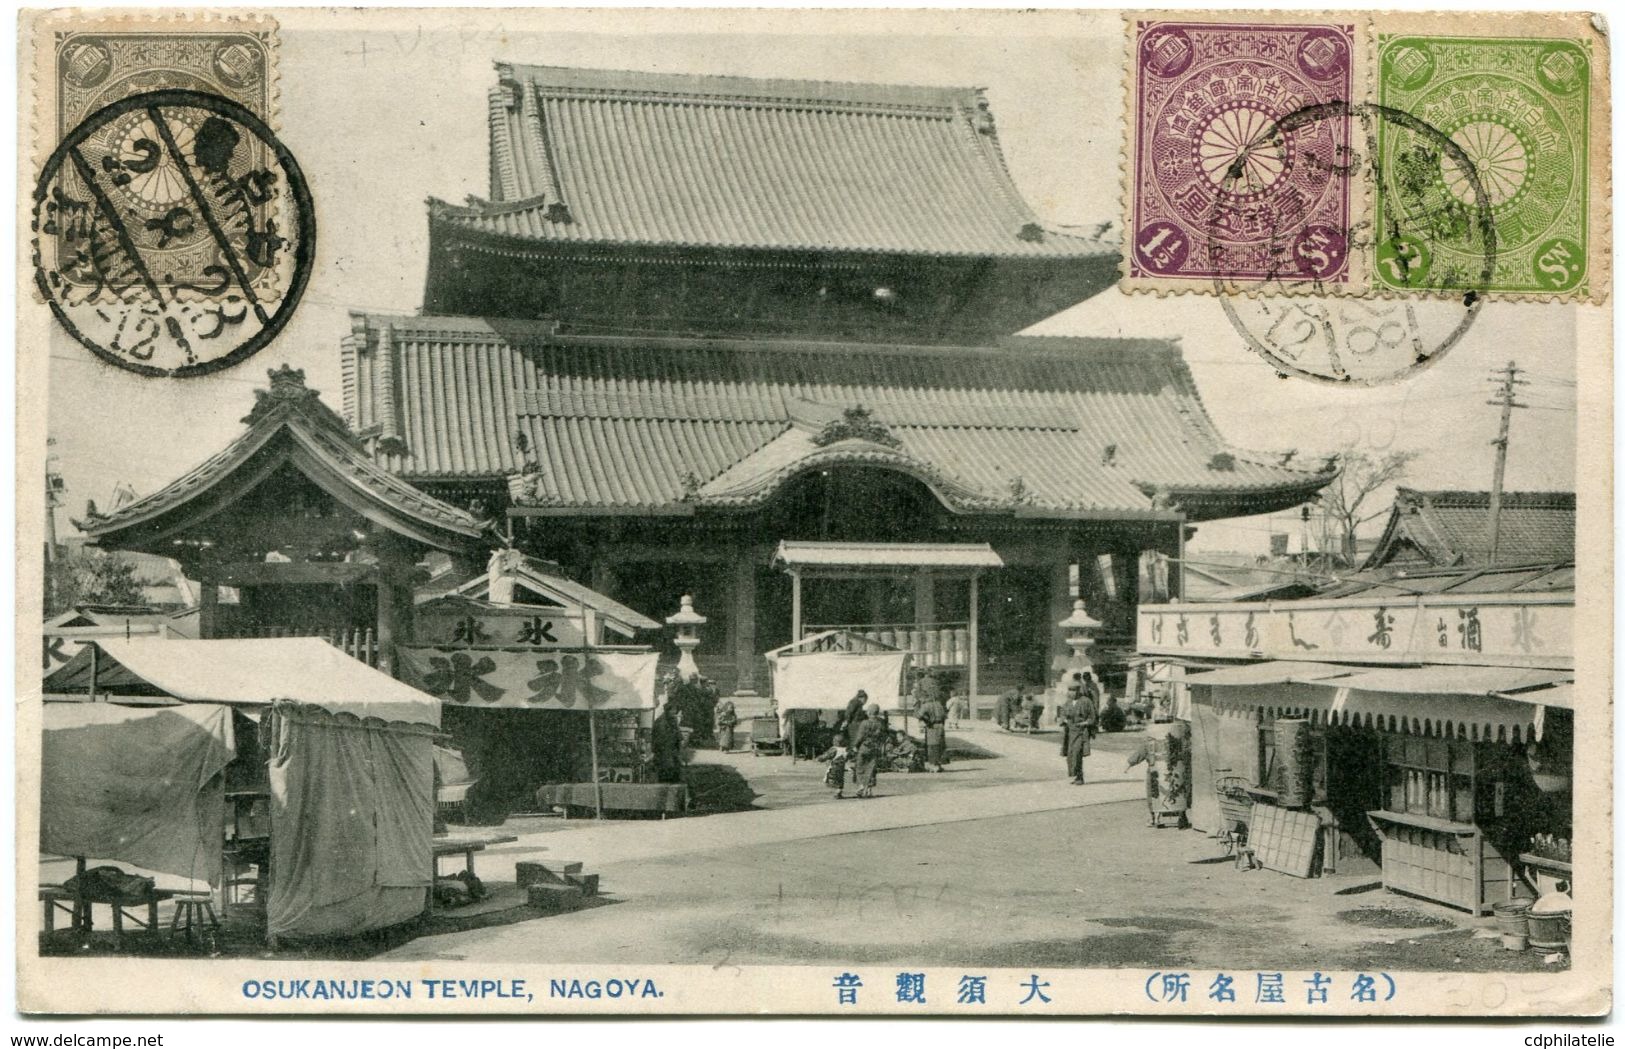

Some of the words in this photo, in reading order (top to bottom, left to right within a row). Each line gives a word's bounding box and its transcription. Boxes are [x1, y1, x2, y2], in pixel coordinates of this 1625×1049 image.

[453, 614, 491, 645] 氷
[516, 614, 558, 646] 氷
[423, 652, 508, 704] 氷
[526, 654, 618, 708] 氷
[422, 978, 534, 1003] TEMPLE,
[550, 978, 665, 1000] NAGOYA.
